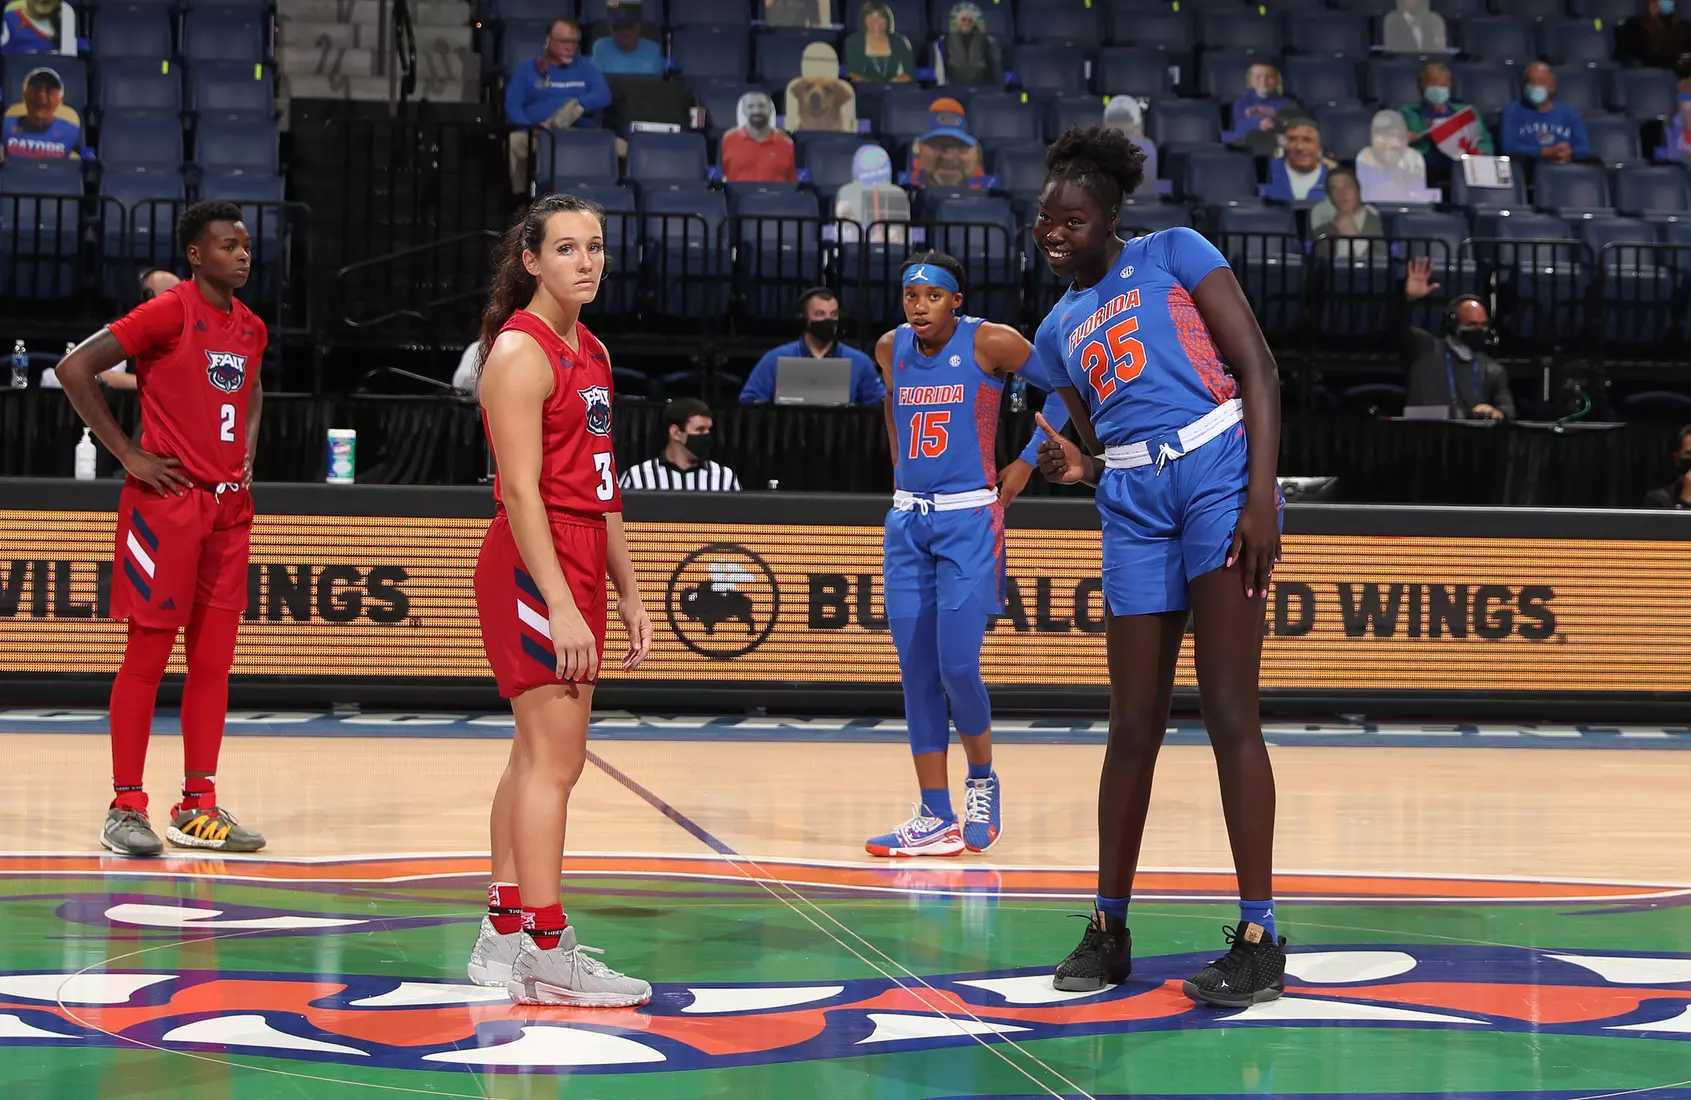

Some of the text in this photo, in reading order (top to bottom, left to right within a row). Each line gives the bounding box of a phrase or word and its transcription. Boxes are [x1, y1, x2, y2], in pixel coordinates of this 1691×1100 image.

[1068, 288, 1141, 358] FLORIDA
[207, 351, 245, 373] FAU
[1081, 316, 1147, 405] 25
[898, 384, 964, 405] FLORIDA
[220, 403, 236, 442] 2
[909, 411, 951, 459] 15
[593, 452, 614, 501] 3
[245, 564, 409, 623] INGS
[808, 574, 1103, 632] BUALO
[1336, 583, 1556, 639] WINGS
